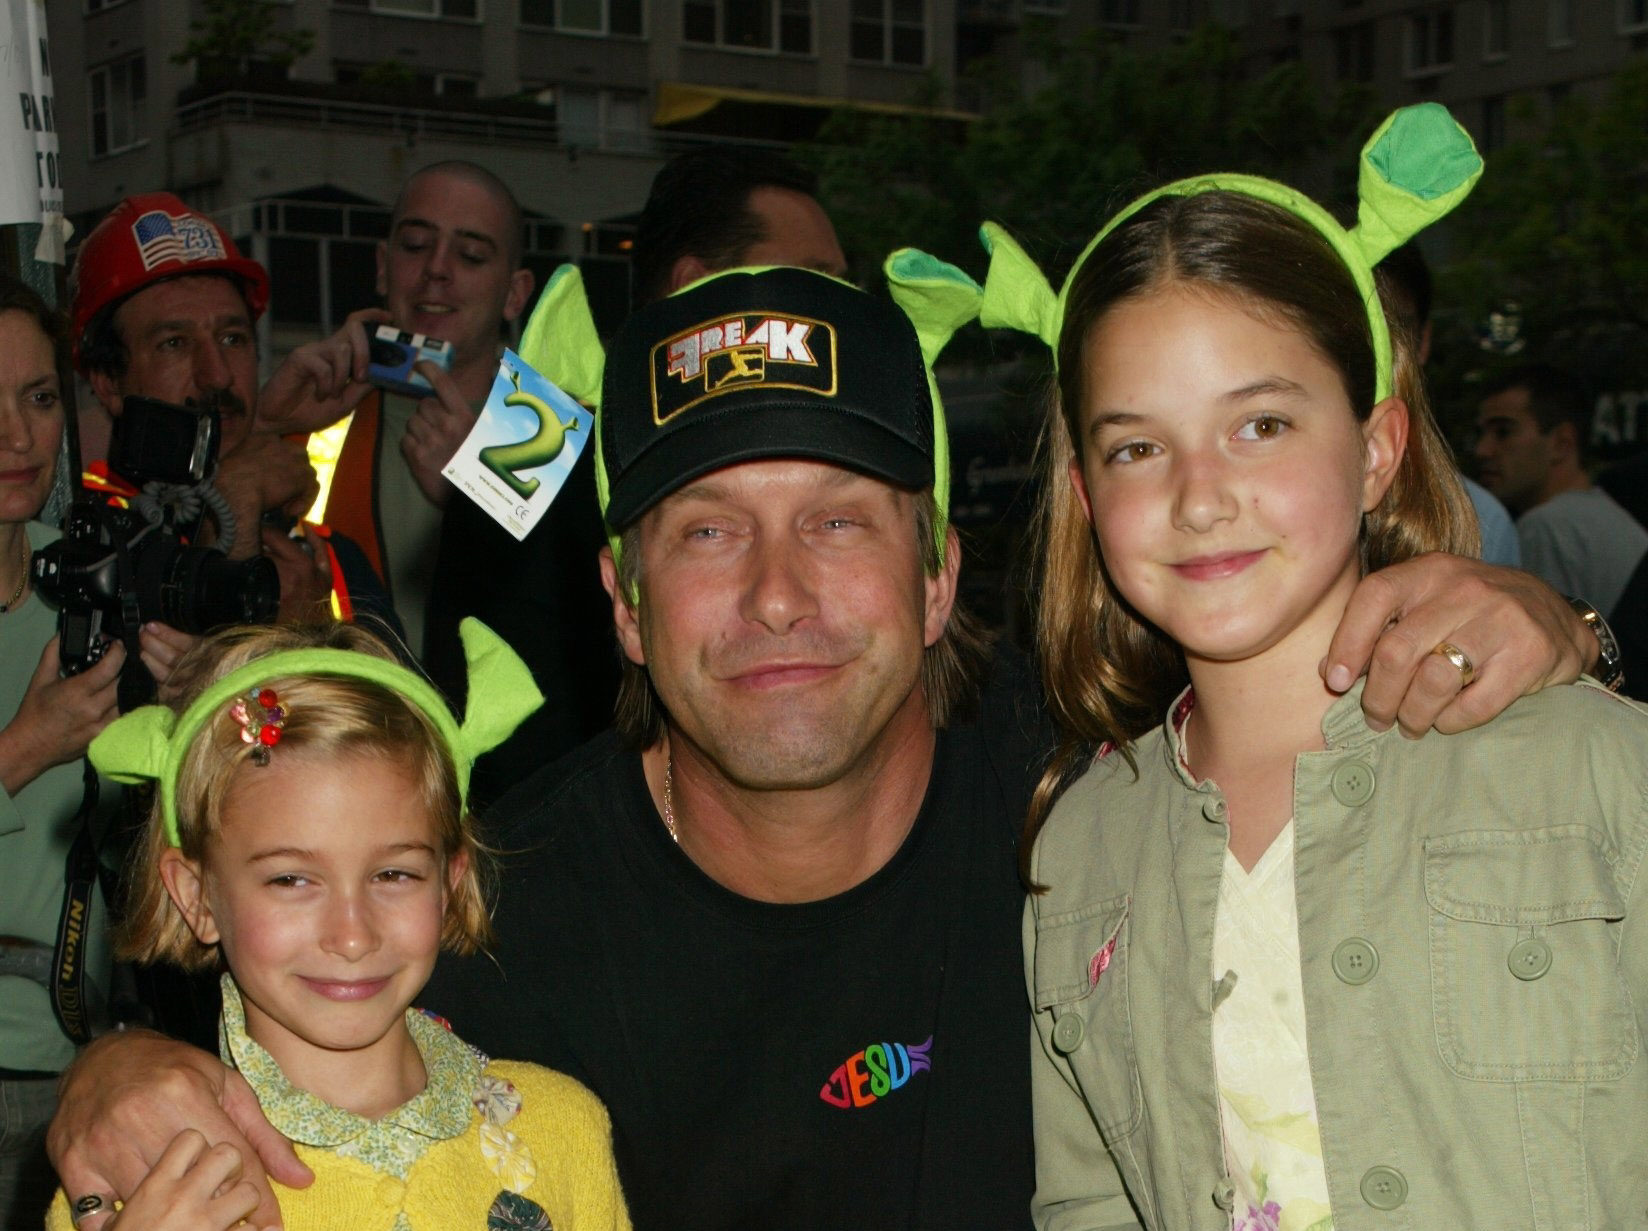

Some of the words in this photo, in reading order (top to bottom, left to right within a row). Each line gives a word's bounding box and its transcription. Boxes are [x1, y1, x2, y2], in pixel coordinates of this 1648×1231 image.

[20, 92, 55, 132] PAR
[36, 151, 63, 189] TO
[178, 227, 217, 249] 731
[667, 317, 818, 384] FREAK
[478, 385, 573, 502] 2
[62, 899, 84, 982] Nikon
